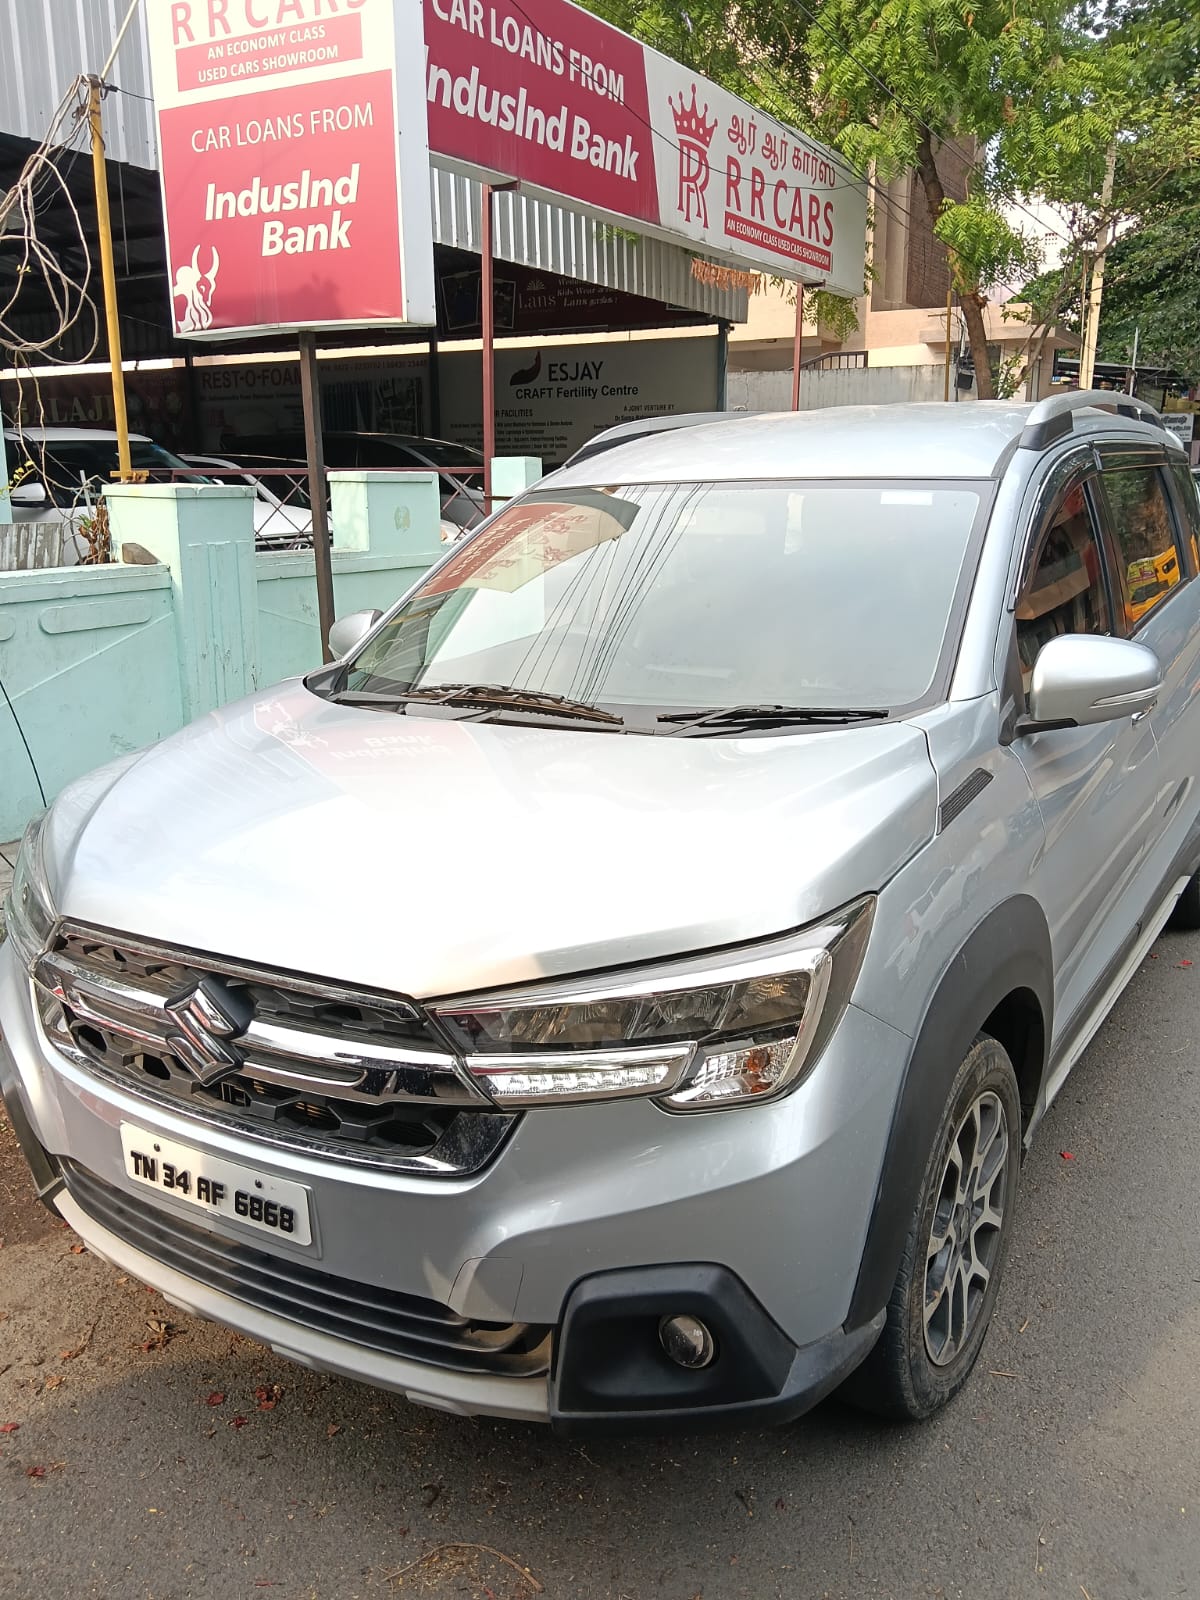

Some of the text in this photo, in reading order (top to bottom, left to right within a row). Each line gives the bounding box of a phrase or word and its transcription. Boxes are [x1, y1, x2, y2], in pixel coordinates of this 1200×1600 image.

[198, 45, 339, 83] USED CARS SHOWROOM
[207, 24, 326, 60] AN ECONOMY CLASS
[490, 8, 564, 76] LOANS
[569, 48, 624, 106] FROM
[191, 102, 374, 153] CAR LOANS FROM
[570, 115, 640, 182] Bank
[727, 114, 757, 155] ஆர்
[761, 132, 788, 171] ஆர்
[205, 163, 360, 221] IndusInd
[773, 179, 834, 247] CARS
[261, 210, 352, 257] Bank
[727, 218, 830, 266] AN ECONOMY CLASS USED CARS SHOWROOM
[515, 384, 639, 400] CRAFT Fertility Centre
[548, 361, 603, 382] ESJAY
[501, 408, 533, 418] FACILITIES
[130, 1150, 294, 1234] TN 34 AF 6868
